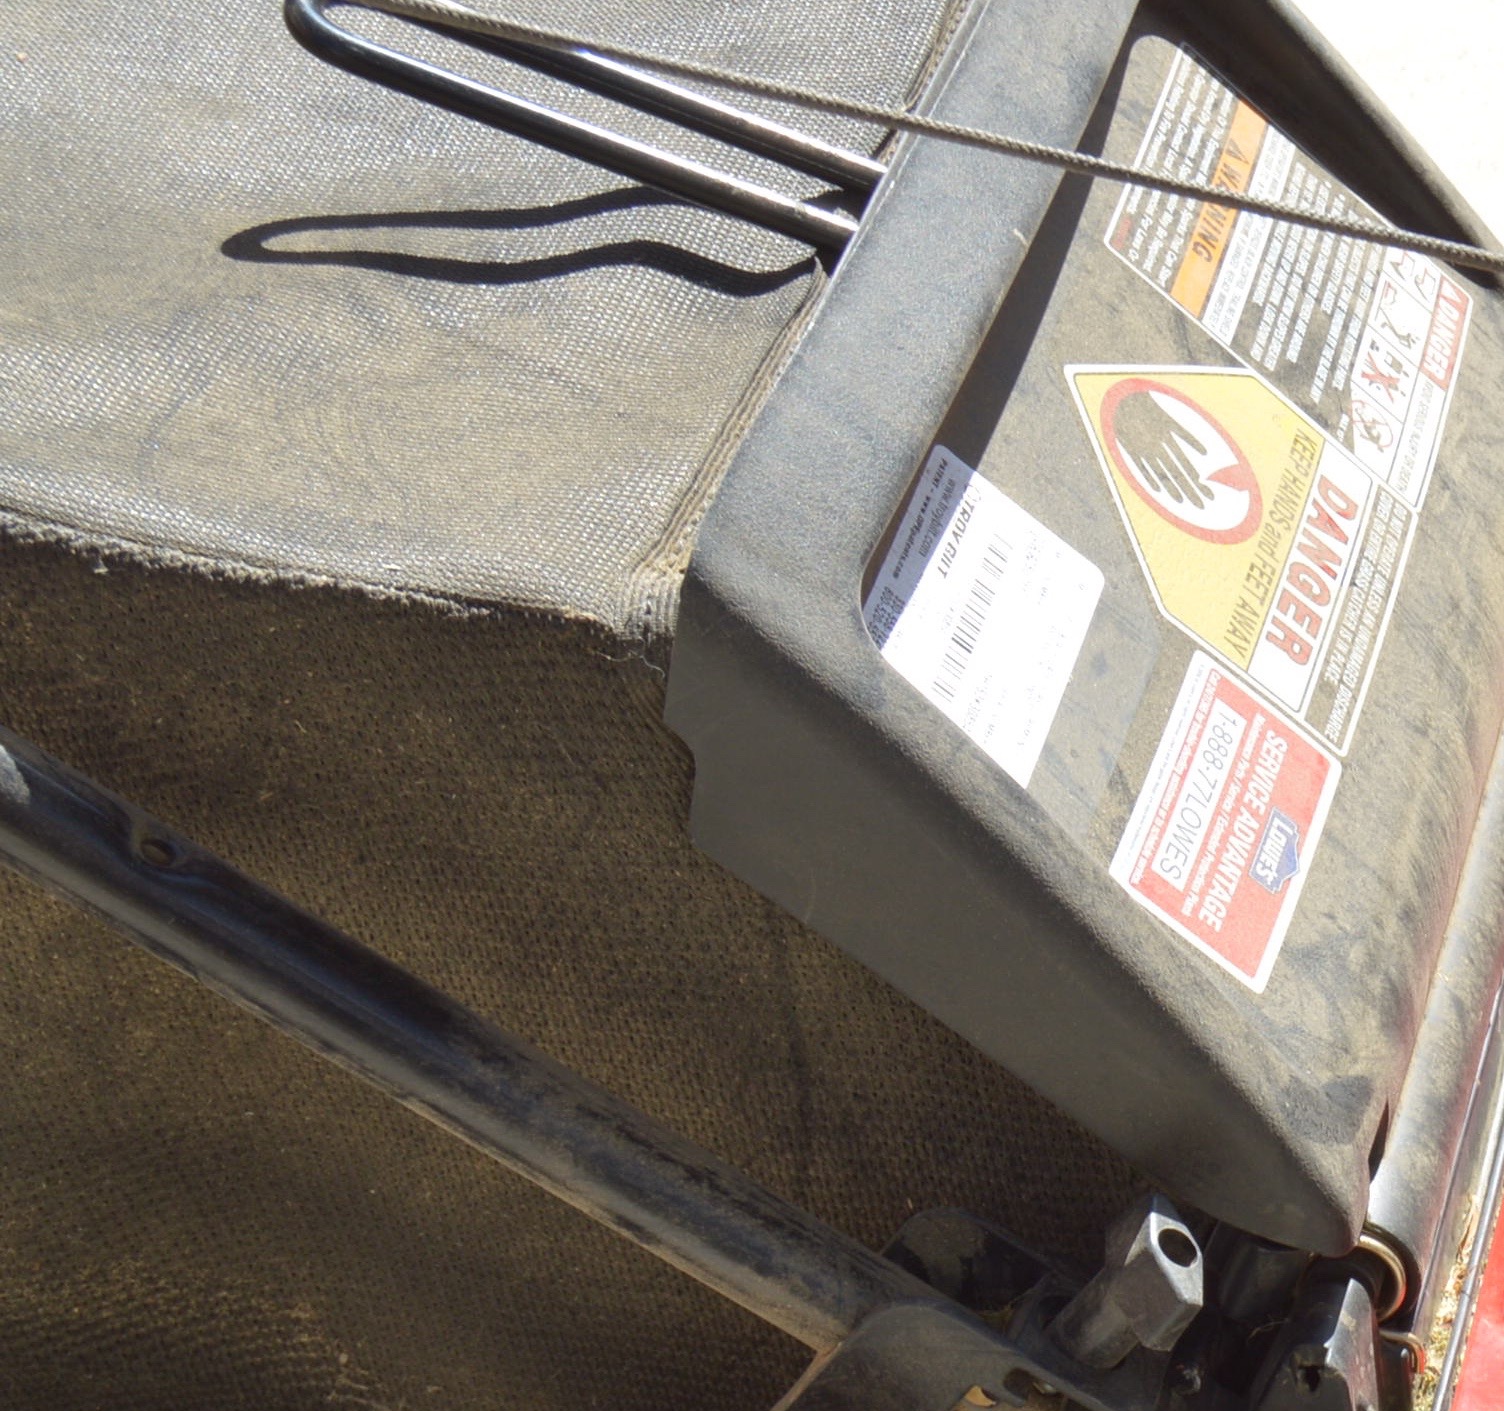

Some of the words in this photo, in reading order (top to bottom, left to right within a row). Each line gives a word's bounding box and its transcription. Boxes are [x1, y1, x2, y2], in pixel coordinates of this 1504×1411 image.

[1421, 294, 1460, 382] DANGER
[1286, 427, 1317, 477] KEEP
[1268, 466, 1304, 533] HANDS
[1374, 489, 1394, 522] COVER
[1392, 501, 1407, 521] DO
[1261, 523, 1286, 563] and
[1363, 529, 1382, 563] ENTIRE
[1371, 517, 1386, 535] OR
[1387, 514, 1404, 539] NOT
[1265, 470, 1360, 673] DANGER
[1354, 557, 1374, 591] GRASS
[1376, 533, 1399, 578] OPERATE
[1242, 551, 1276, 607] FEET
[1365, 571, 1388, 614] UNLESS
[1224, 594, 1260, 661] AWAY
[1342, 585, 1365, 630] CATCHER
[1361, 608, 1377, 630] AN
[1334, 635, 1349, 655] IN
[1338, 624, 1352, 642] IS
[1323, 648, 1345, 689] PLACE.
[1341, 622, 1372, 690] UNDAMAGED
[1323, 682, 1352, 744] DISCHARGE
[1241, 727, 1289, 816] SERVICE
[1197, 804, 1260, 935] ADVANTAGE
